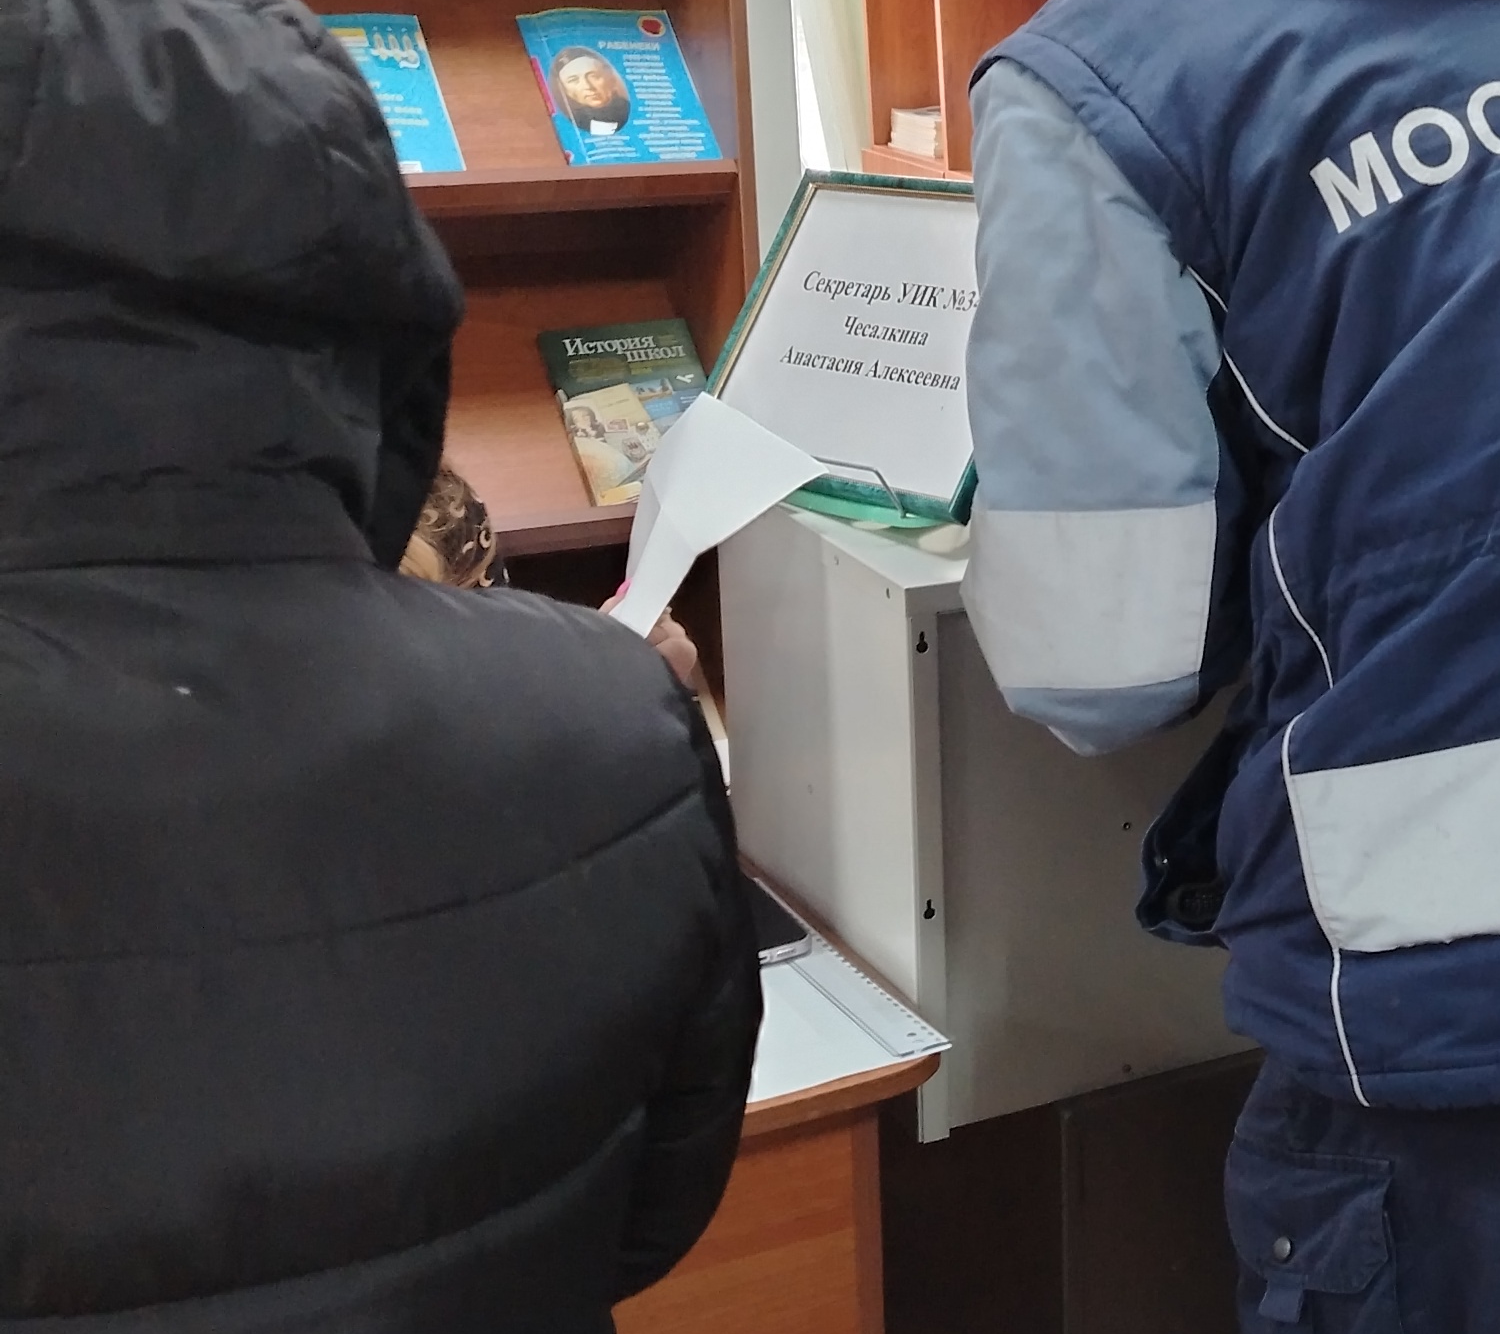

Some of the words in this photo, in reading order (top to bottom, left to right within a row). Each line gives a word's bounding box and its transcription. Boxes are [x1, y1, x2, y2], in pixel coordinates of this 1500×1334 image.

[803, 270, 892, 306] Секретарь
[897, 282, 944, 308] УИК
[844, 315, 929, 346] Чесалкина
[562, 336, 656, 357] История
[626, 345, 686, 362] школ
[780, 345, 864, 376] Анастасия
[865, 359, 961, 391] Алексеевна
